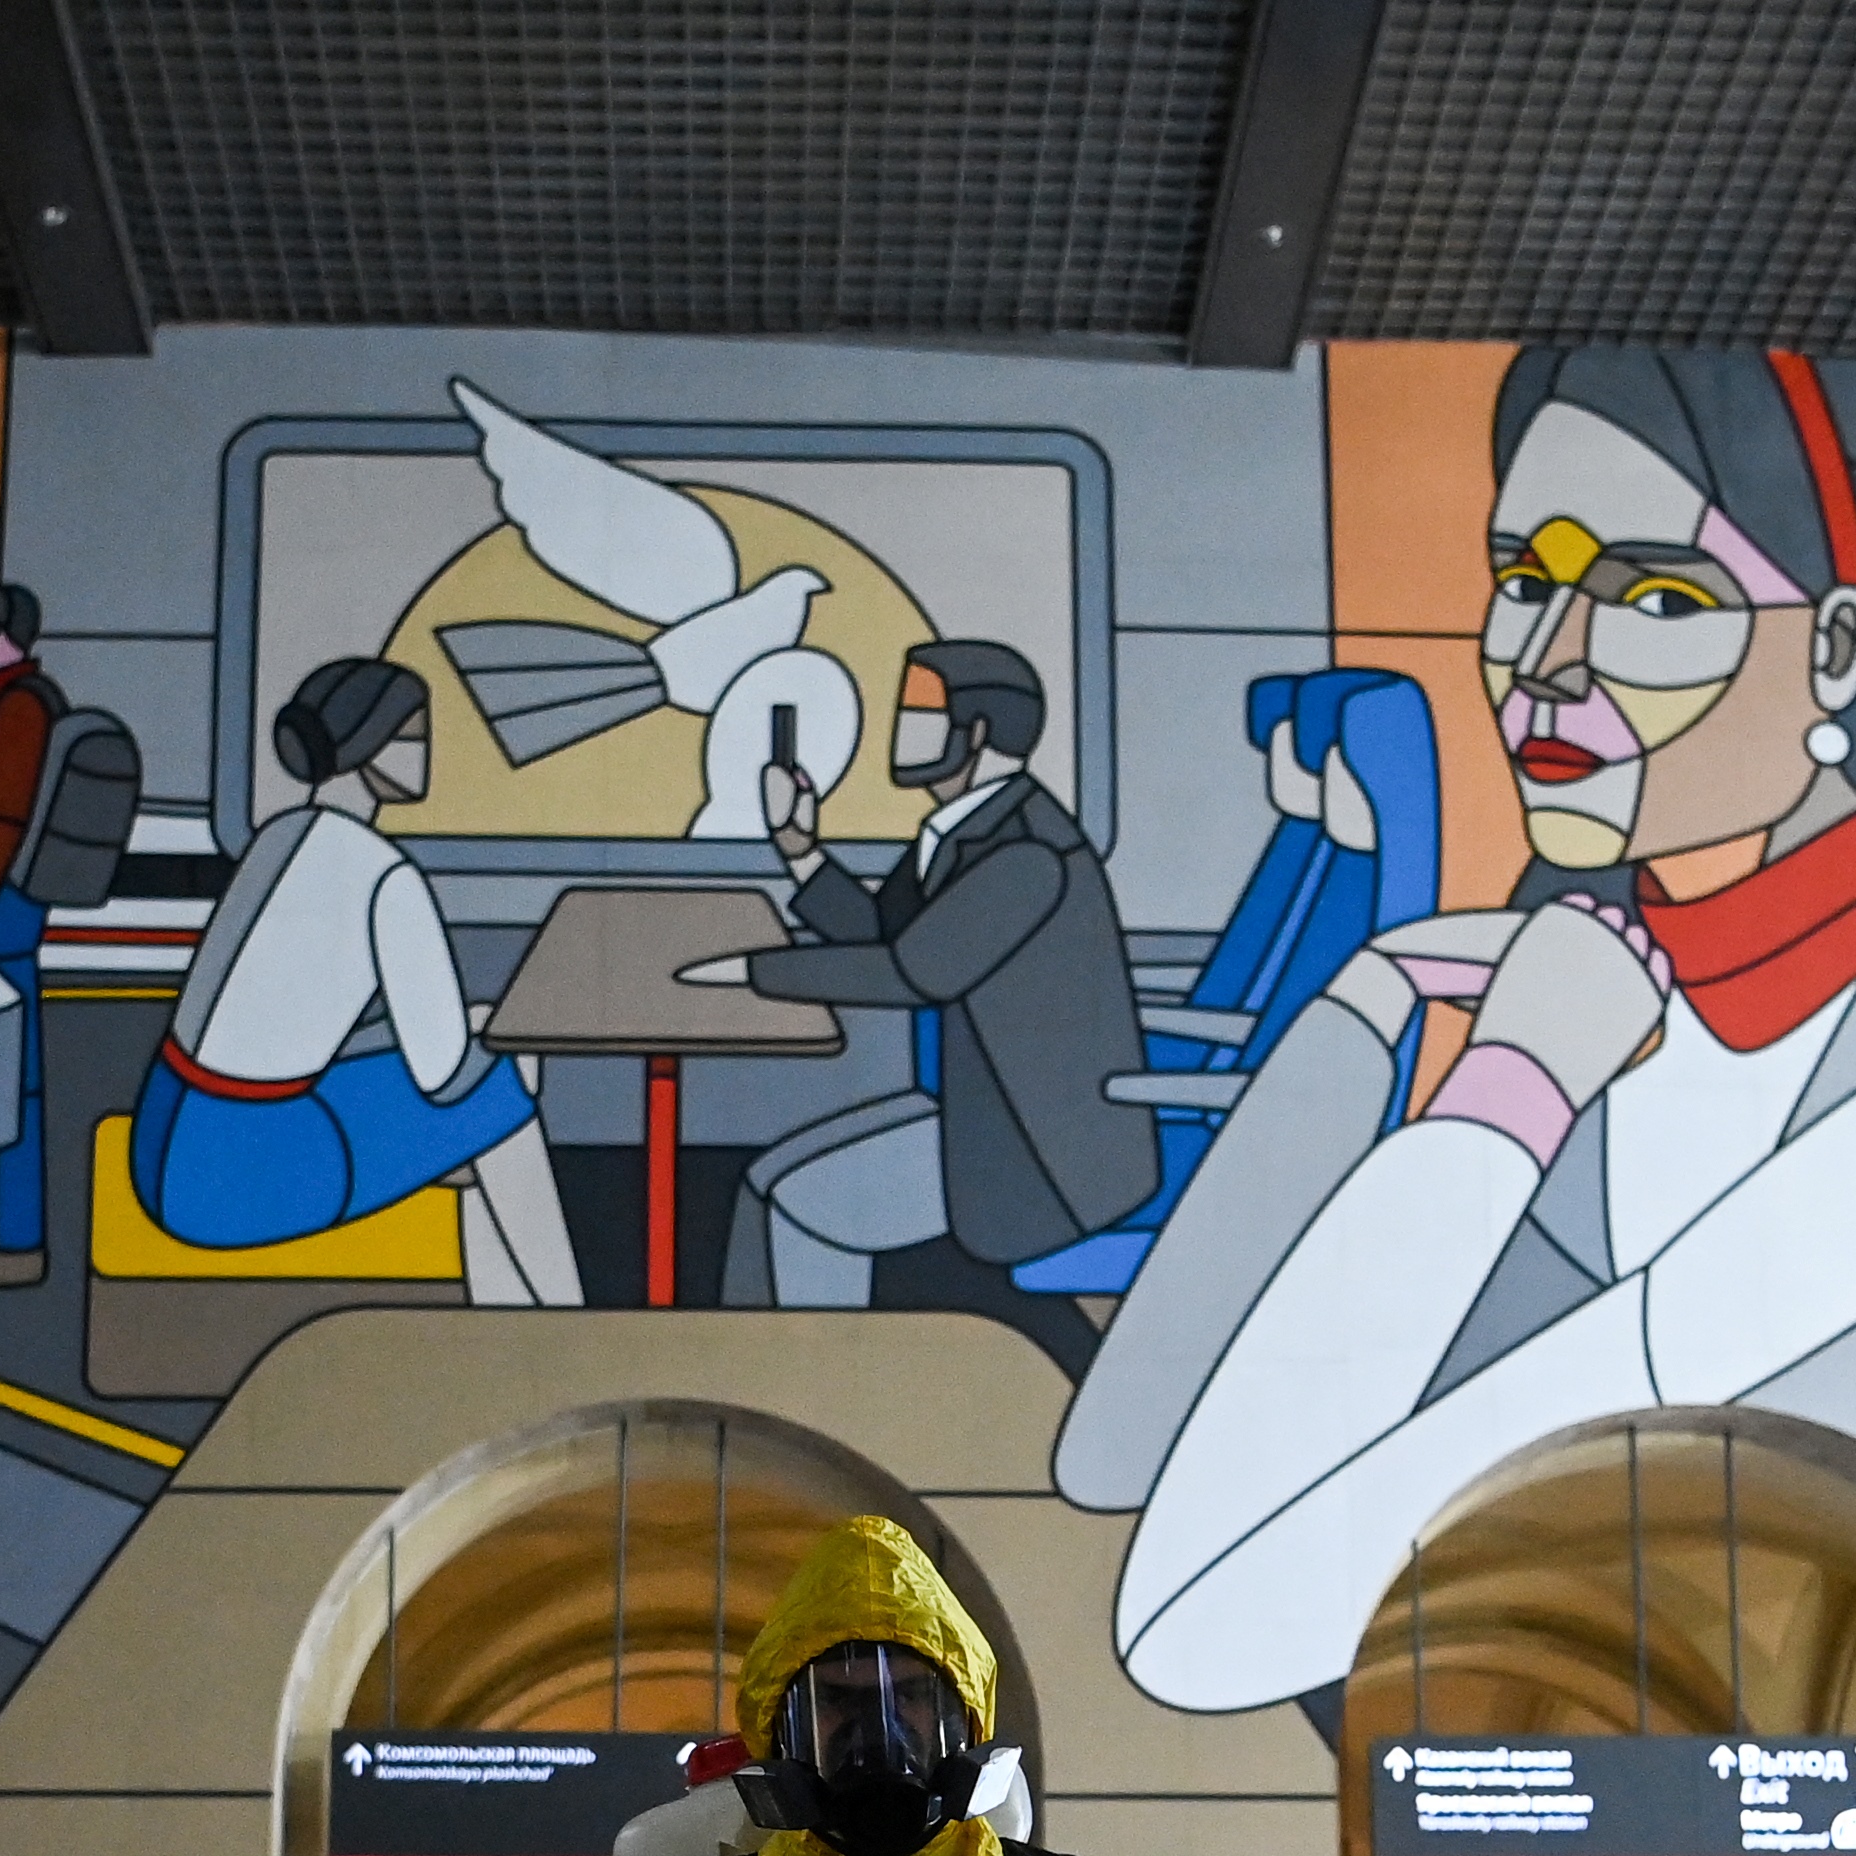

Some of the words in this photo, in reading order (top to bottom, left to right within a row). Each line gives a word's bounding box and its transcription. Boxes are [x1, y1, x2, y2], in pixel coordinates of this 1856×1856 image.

[374, 1742, 515, 1763] Комсомольская
[516, 1746, 597, 1766] площадь
[1738, 1743, 1849, 1782] Выход
